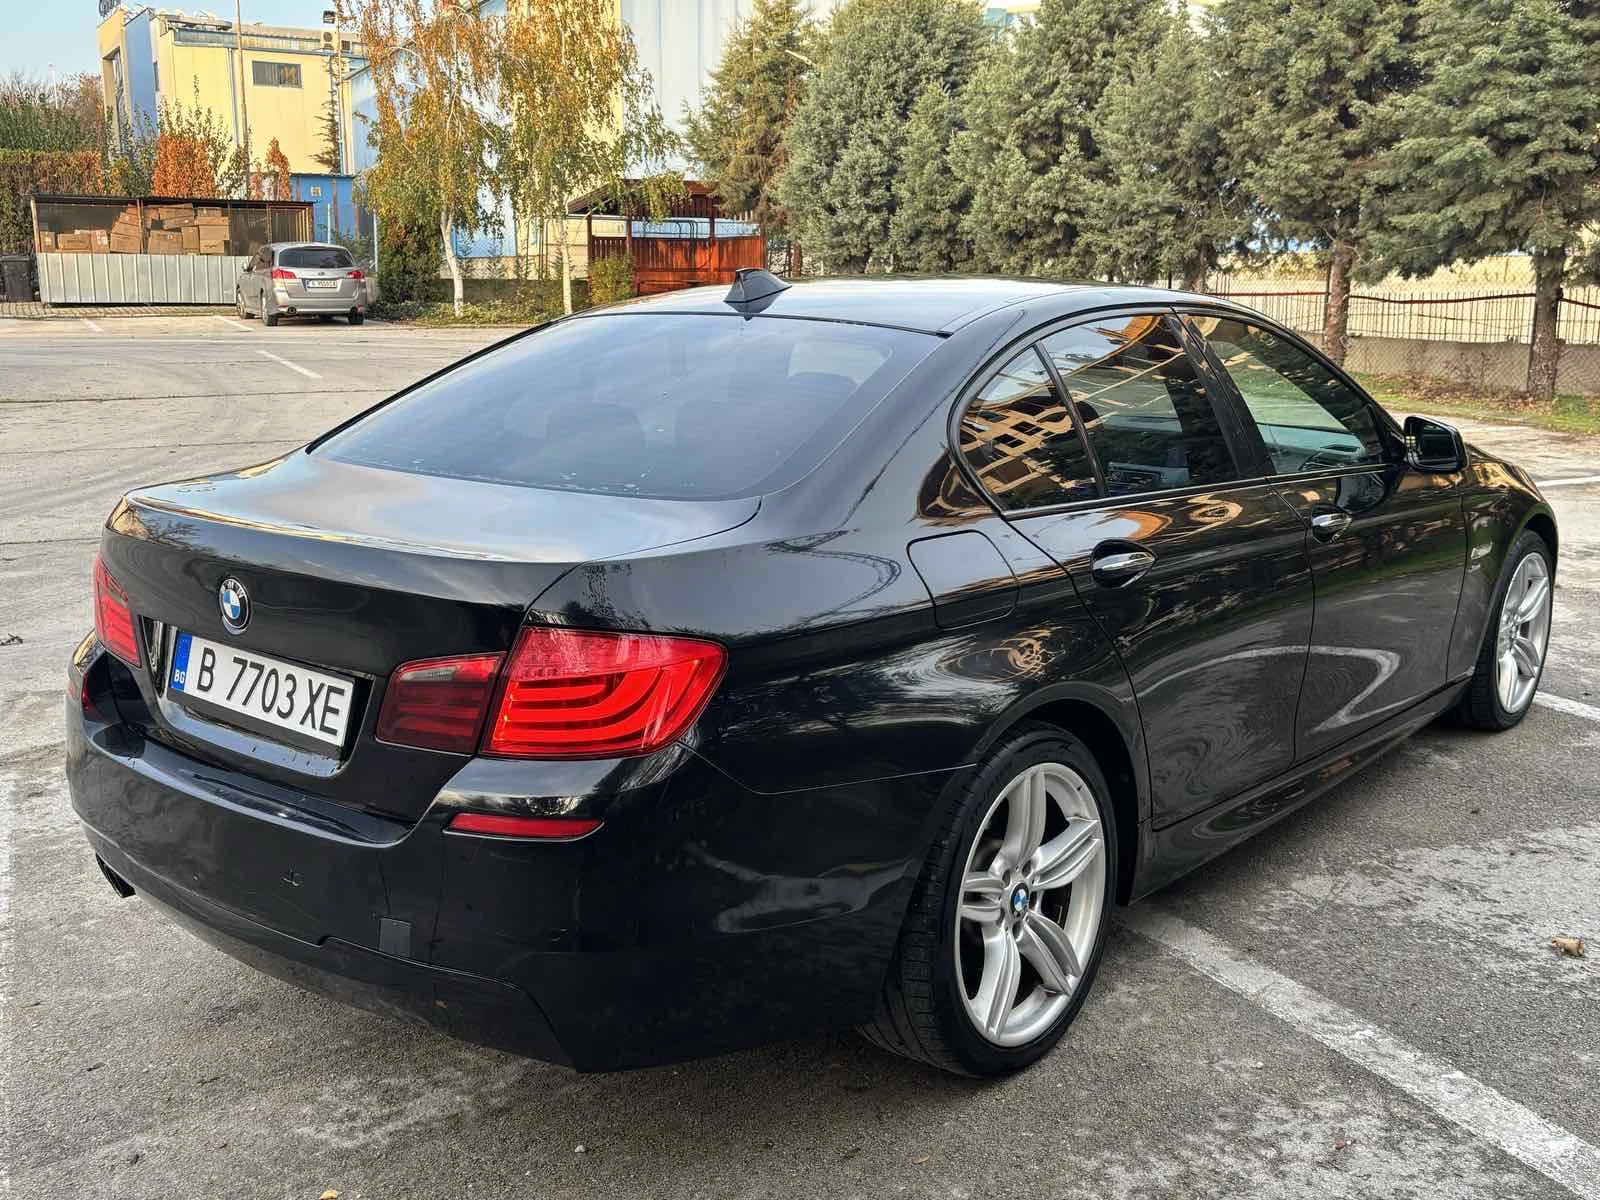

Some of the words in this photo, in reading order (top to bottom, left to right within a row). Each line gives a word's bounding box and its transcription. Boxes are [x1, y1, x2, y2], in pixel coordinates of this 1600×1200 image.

[174, 669, 186, 684] BG
[197, 647, 216, 692] B
[226, 656, 297, 719] 7703
[299, 678, 345, 736] XE
